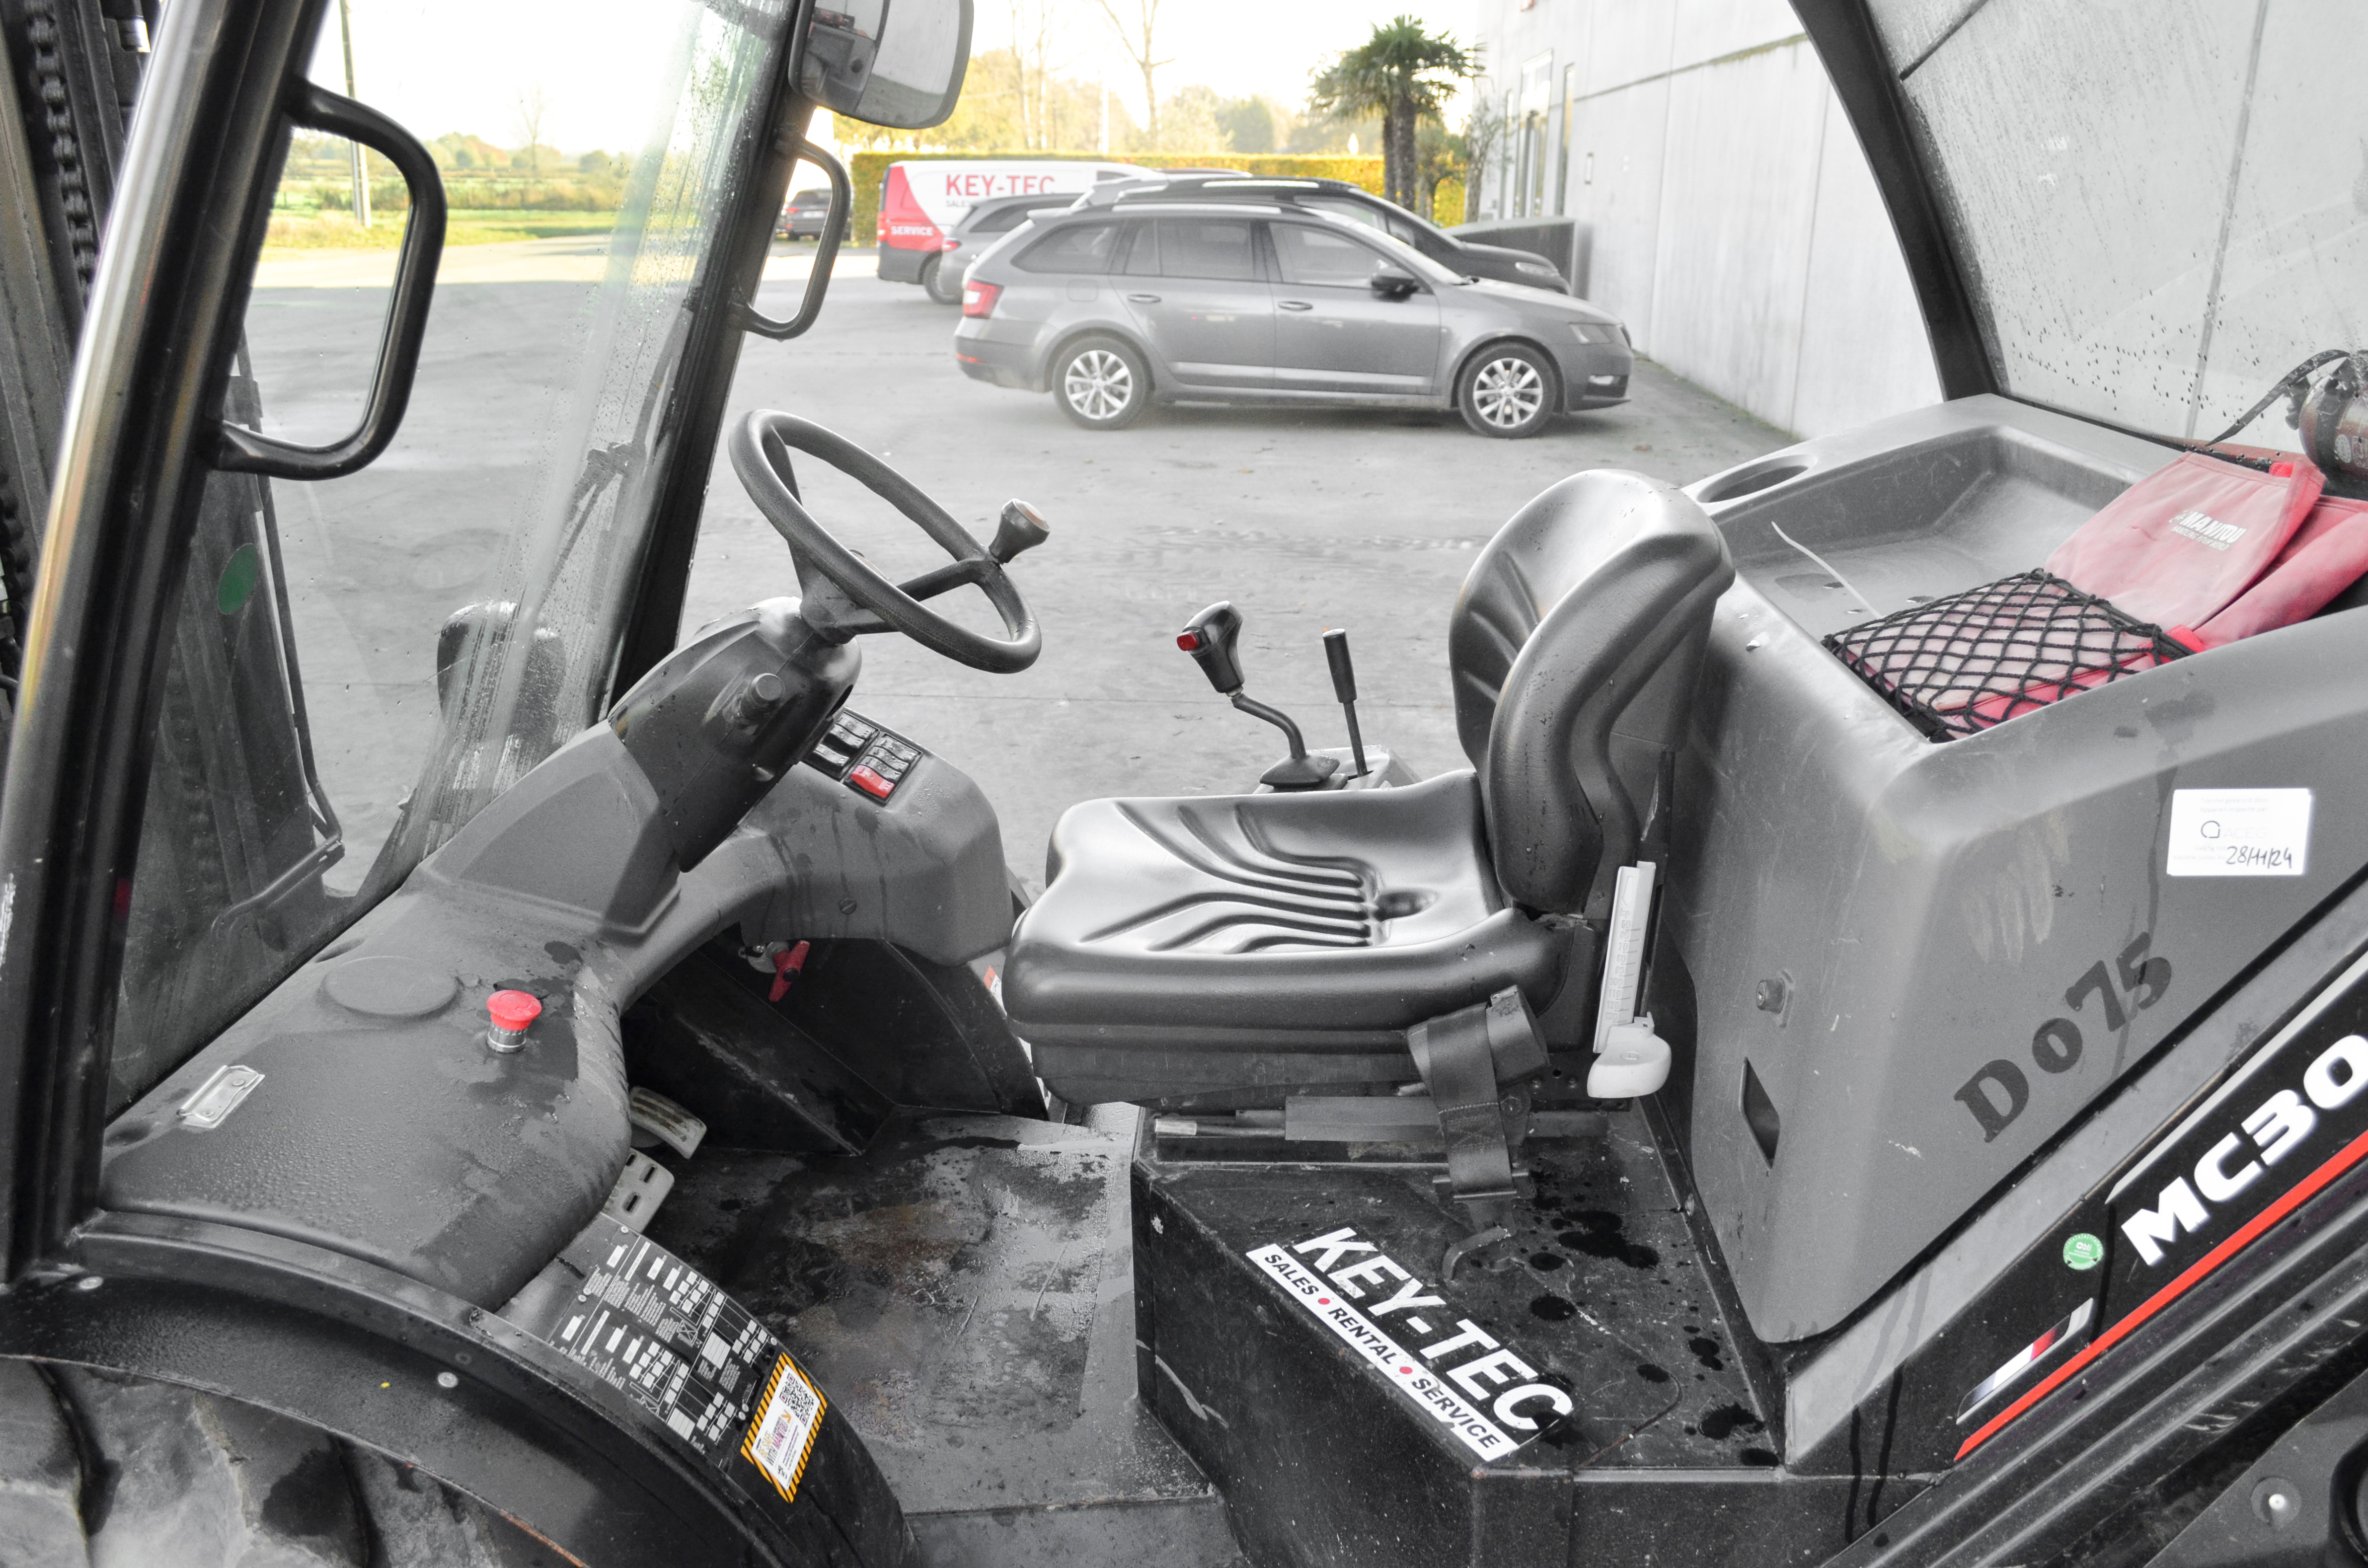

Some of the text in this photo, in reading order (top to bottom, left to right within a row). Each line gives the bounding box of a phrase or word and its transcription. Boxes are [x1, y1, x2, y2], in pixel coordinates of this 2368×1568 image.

[891, 225, 933, 236] SERVICE
[2179, 511, 2247, 544] MANITOU
[2222, 826, 2267, 839] ACEG
[2120, 1034, 2368, 1267] MC30
[1293, 1227, 1573, 1430] KEY-TEC
[1264, 1253, 1502, 1449] SALES RENTAL SERVICE
[761, 1429, 773, 1450] SAFE
[771, 1419, 789, 1450] MANITOU
[765, 1445, 778, 1466] WITH
